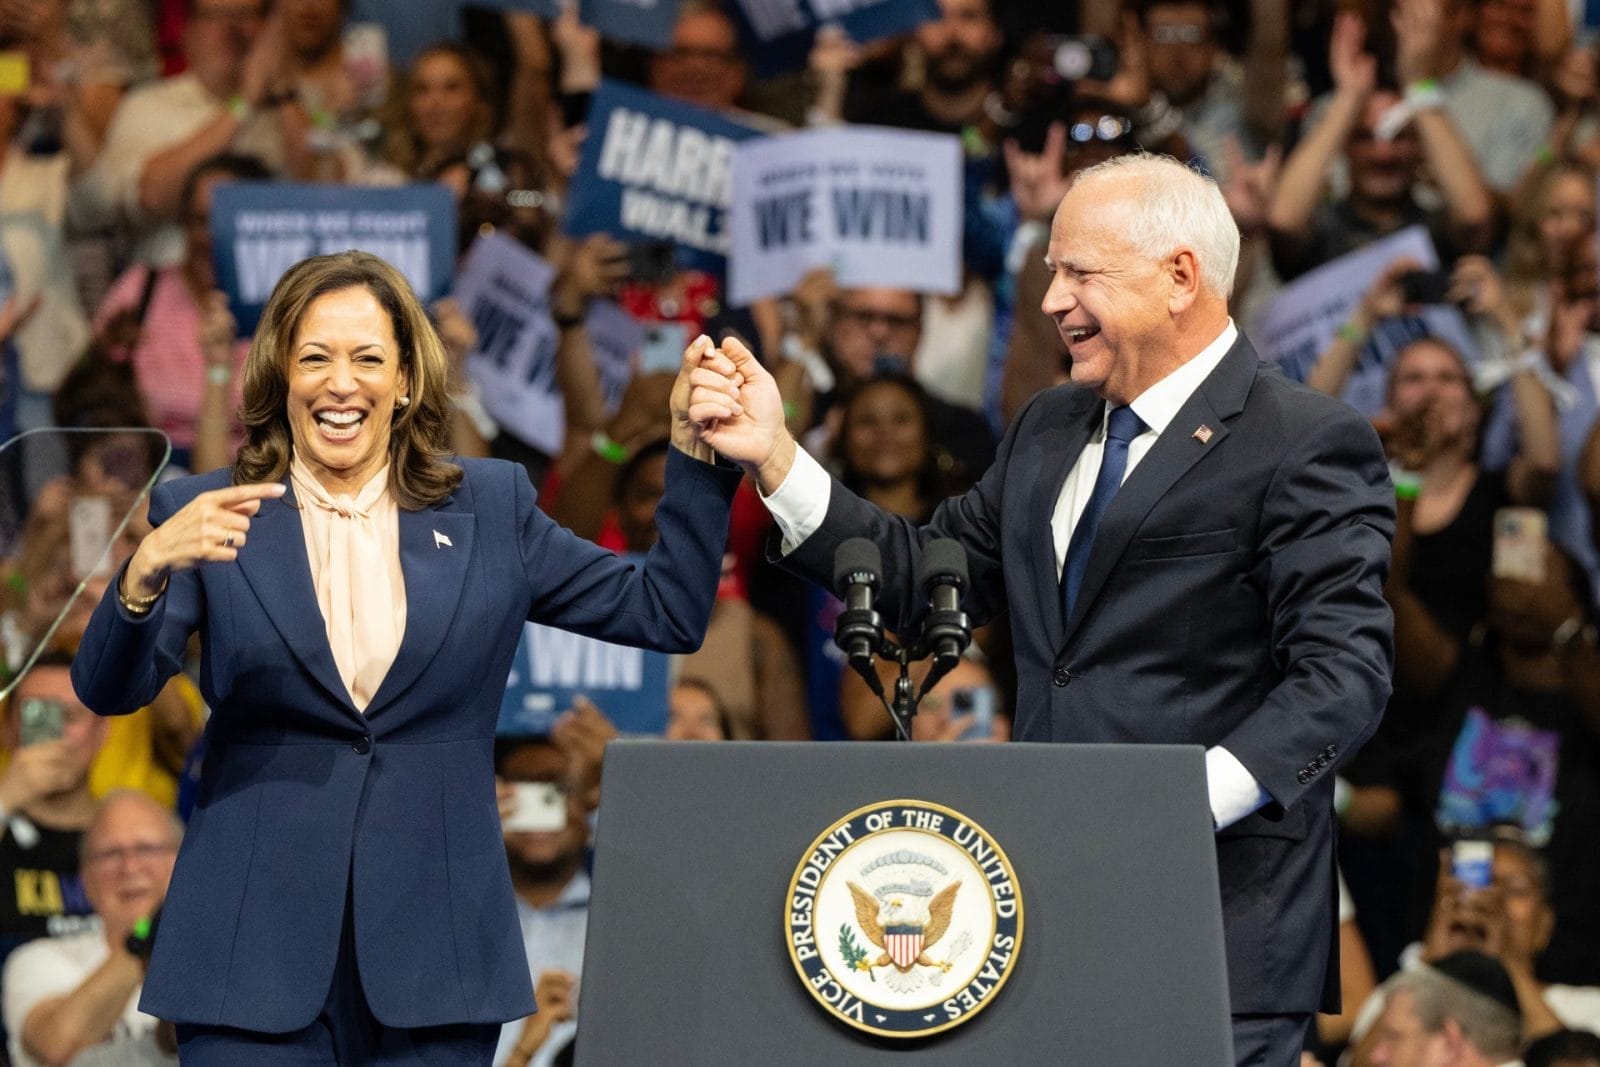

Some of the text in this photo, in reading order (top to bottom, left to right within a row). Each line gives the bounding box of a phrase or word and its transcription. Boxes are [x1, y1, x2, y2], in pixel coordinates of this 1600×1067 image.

[597, 107, 735, 206] HARR
[755, 187, 930, 253] WE WIN
[523, 621, 643, 692] WIN
[865, 810, 894, 831] OF
[901, 809, 944, 832] THE
[791, 823, 855, 961] PRESIDENT
[953, 822, 1017, 918] UNITED
[810, 967, 865, 1024] VICE
[943, 933, 1015, 1019] STATES
